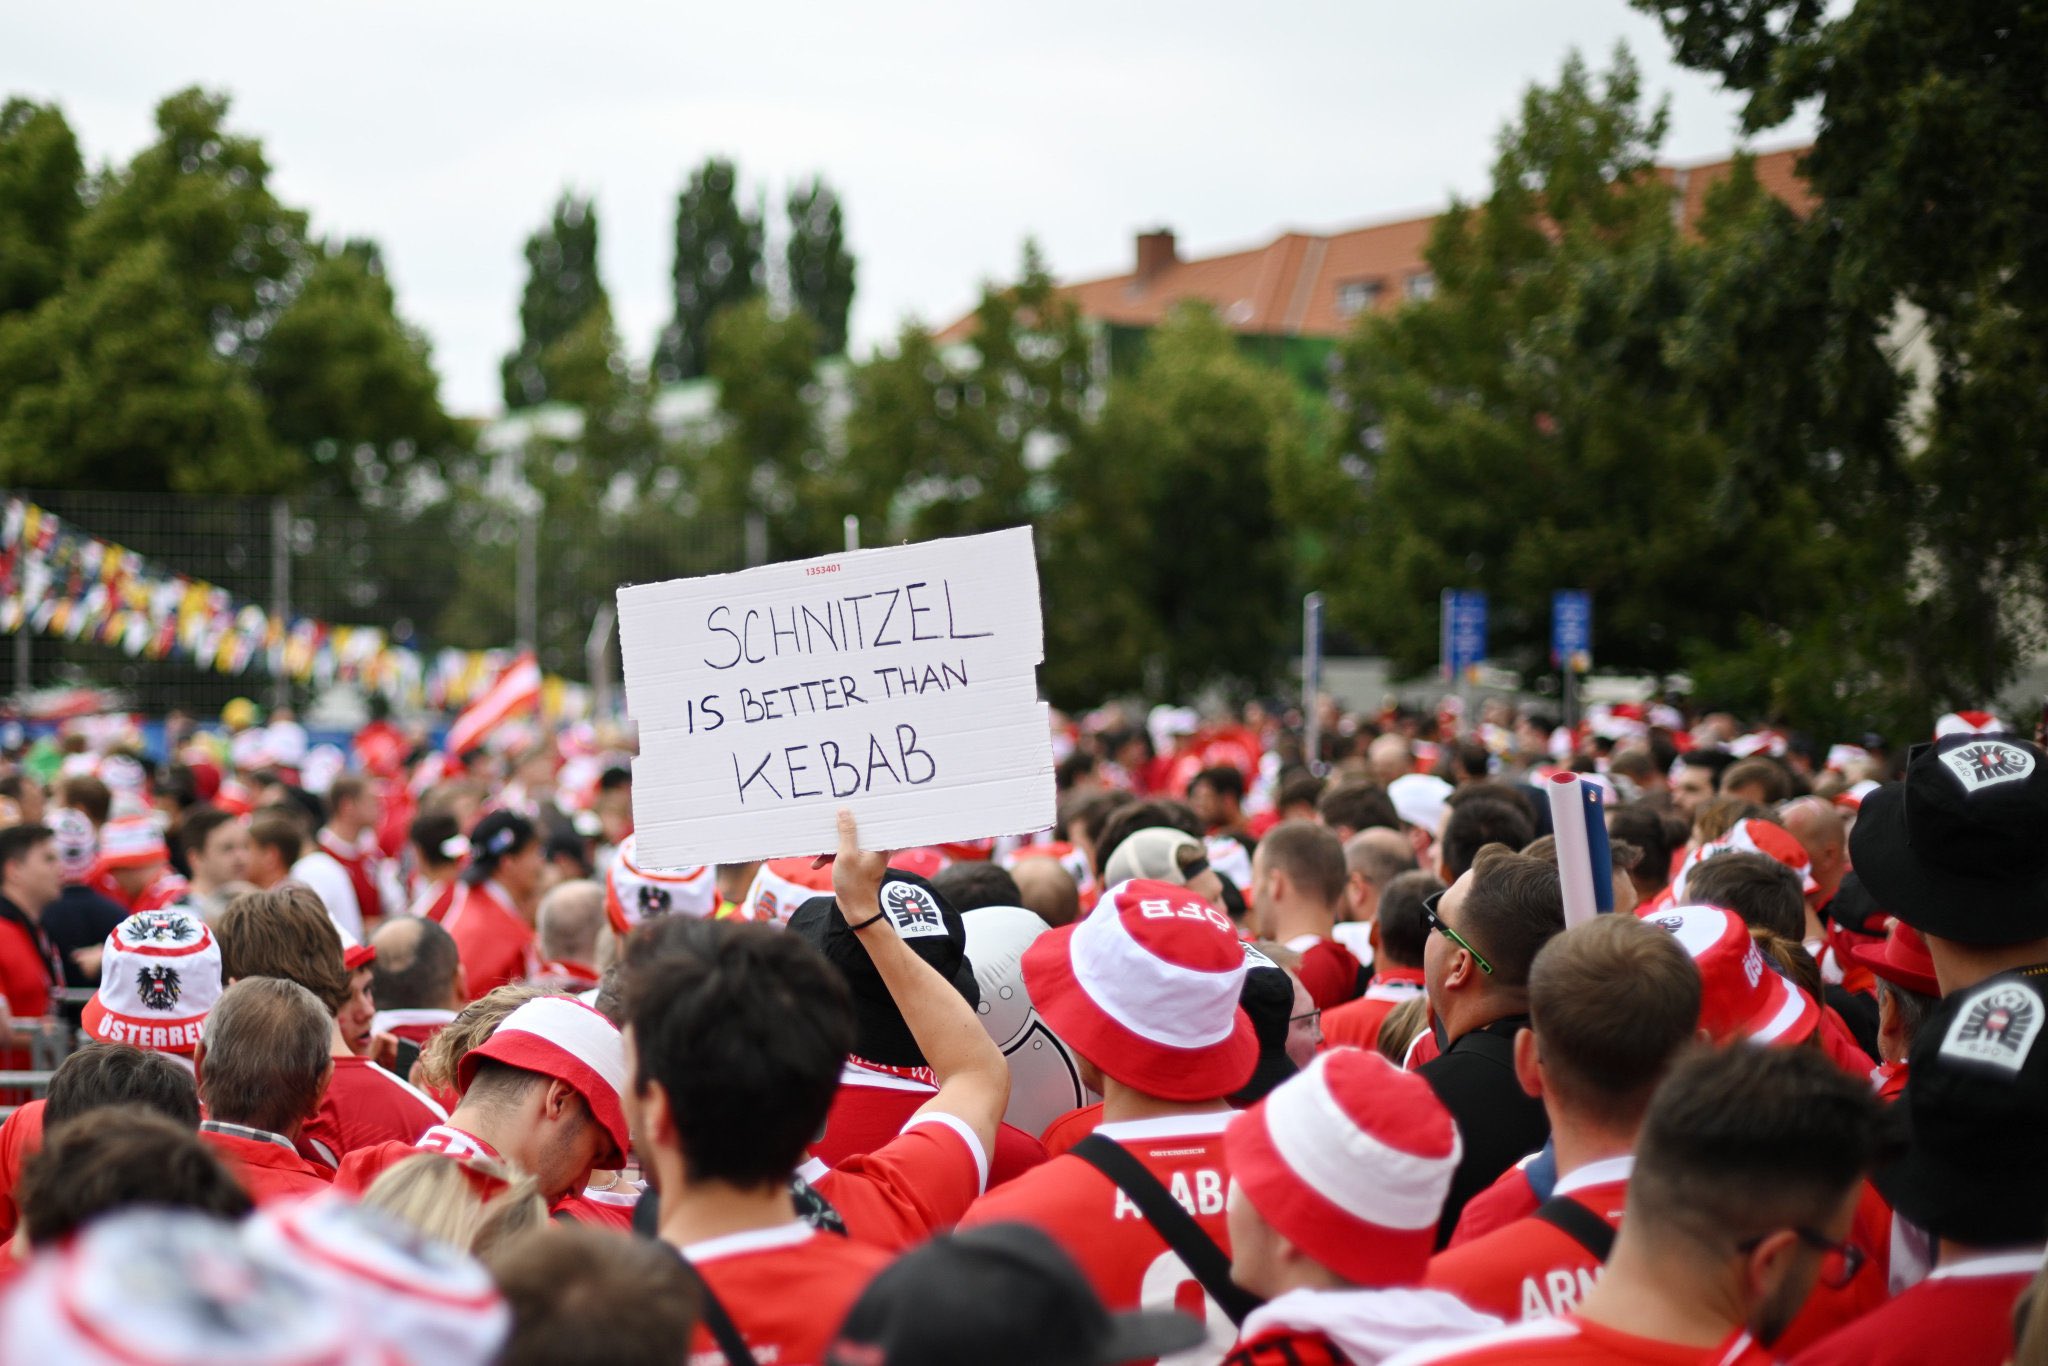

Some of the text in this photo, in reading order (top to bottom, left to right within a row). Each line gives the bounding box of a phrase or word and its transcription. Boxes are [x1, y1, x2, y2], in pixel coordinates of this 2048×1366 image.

[806, 563, 842, 576] 1353401
[703, 579, 995, 670] SCHNITZEL
[687, 658, 969, 734] IS BETTER THAN
[732, 723, 936, 804] KEBAB
[1139, 899, 1231, 932] ÖFB
